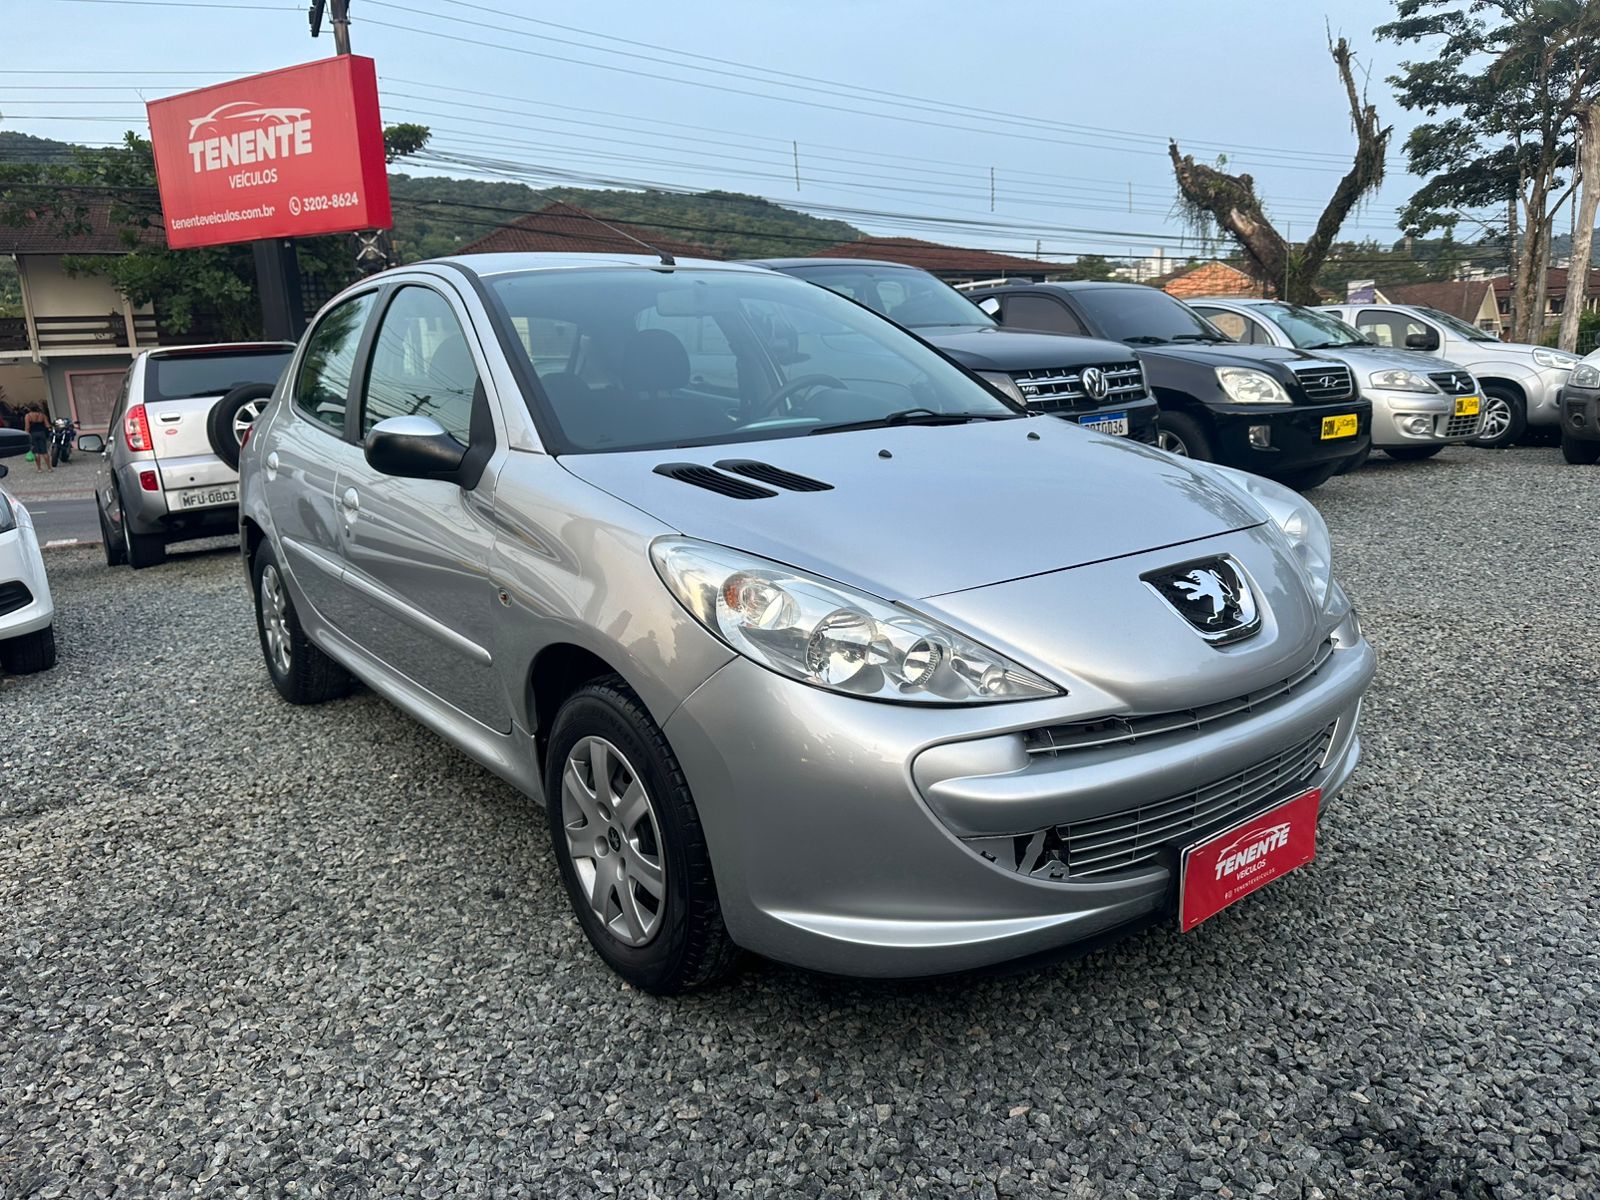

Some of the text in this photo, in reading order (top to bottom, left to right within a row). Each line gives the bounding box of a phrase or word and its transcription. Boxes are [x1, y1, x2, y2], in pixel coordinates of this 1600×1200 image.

[188, 119, 312, 173] TENENTE
[228, 168, 278, 189] VEÍCULOS
[302, 192, 359, 212] 3202-8624
[171, 204, 276, 230] tenenteveiculos.com.br
[1215, 826, 1290, 880] TENENTE
